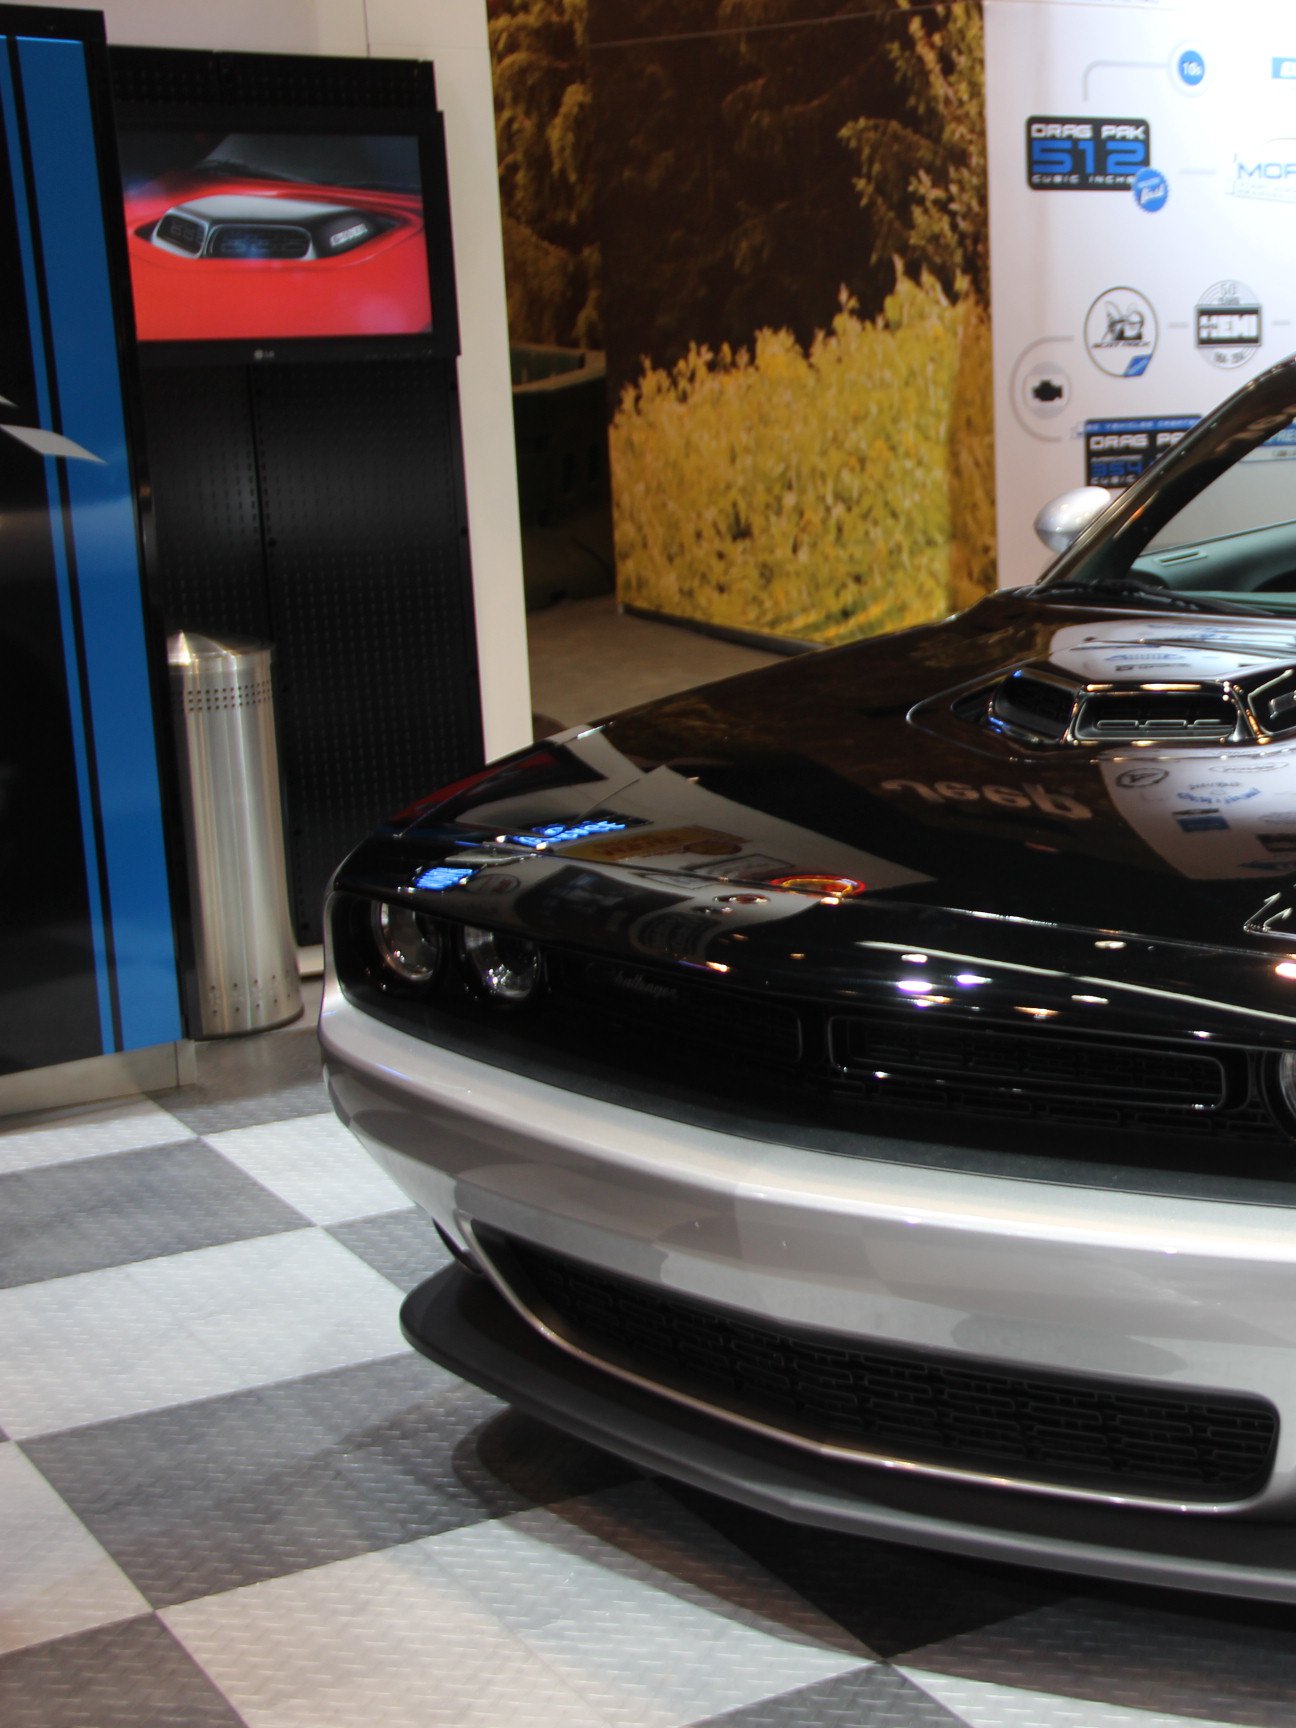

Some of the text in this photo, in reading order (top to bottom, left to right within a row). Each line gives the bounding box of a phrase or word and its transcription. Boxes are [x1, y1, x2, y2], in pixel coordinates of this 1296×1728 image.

[1031, 124, 1146, 140] DRAG PAK
[1032, 140, 1146, 174] 512
[1031, 174, 1080, 184] CUBIC
[1199, 314, 1257, 339] HEMI
[1090, 434, 1149, 450] DRAG
